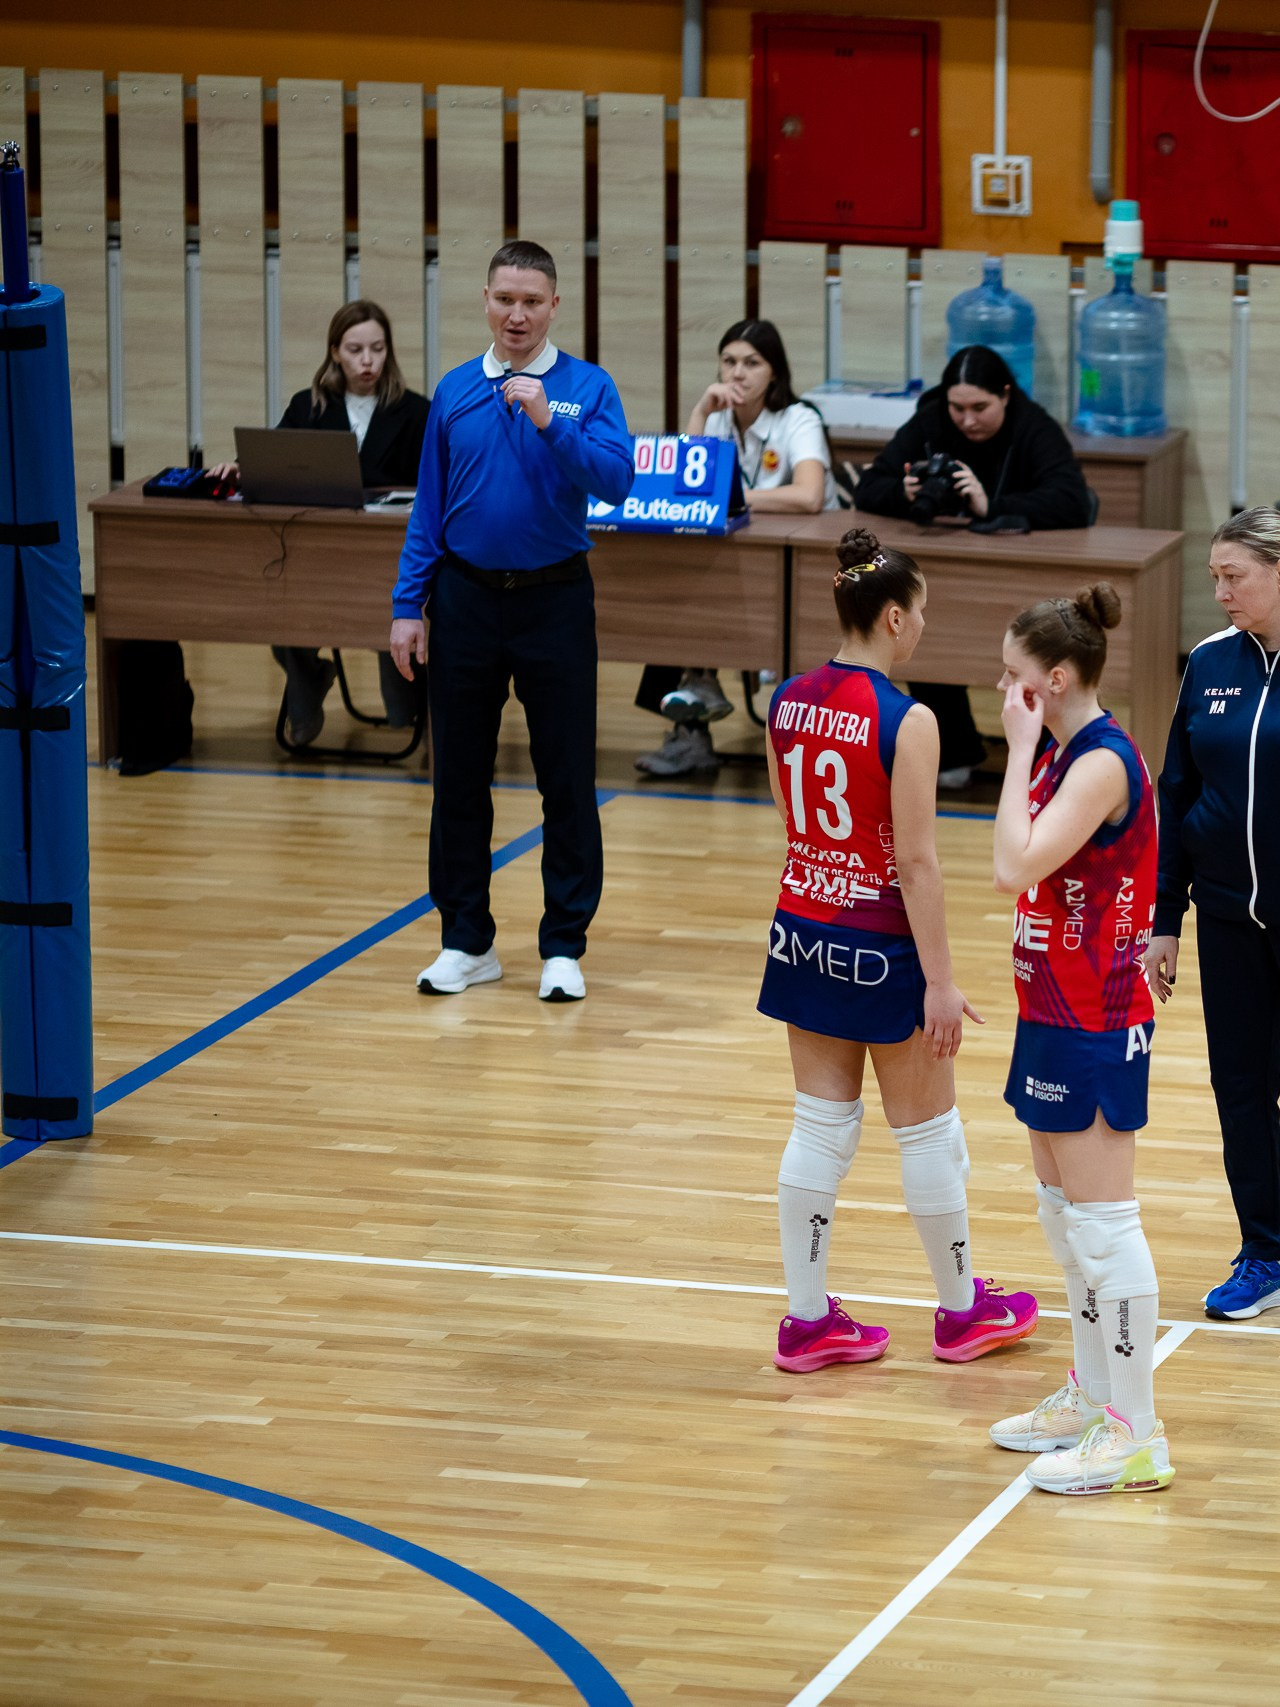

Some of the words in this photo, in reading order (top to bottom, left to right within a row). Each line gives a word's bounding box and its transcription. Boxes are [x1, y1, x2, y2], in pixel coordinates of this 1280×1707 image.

[548, 400, 582, 417] ВФВ
[683, 445, 708, 488] 8
[622, 497, 720, 525] Butterfly
[1204, 687, 1242, 697] KELME
[775, 700, 871, 747] ПОТАТУЕВА
[783, 743, 853, 840] 13
[810, 891, 855, 909] VISION
[1063, 877, 1086, 951] A2MED
[1114, 876, 1134, 952] A2MED
[768, 919, 889, 986] 2MED
[1034, 1079, 1070, 1094] GLOBAL
[1034, 1090, 1063, 1102] VISION
